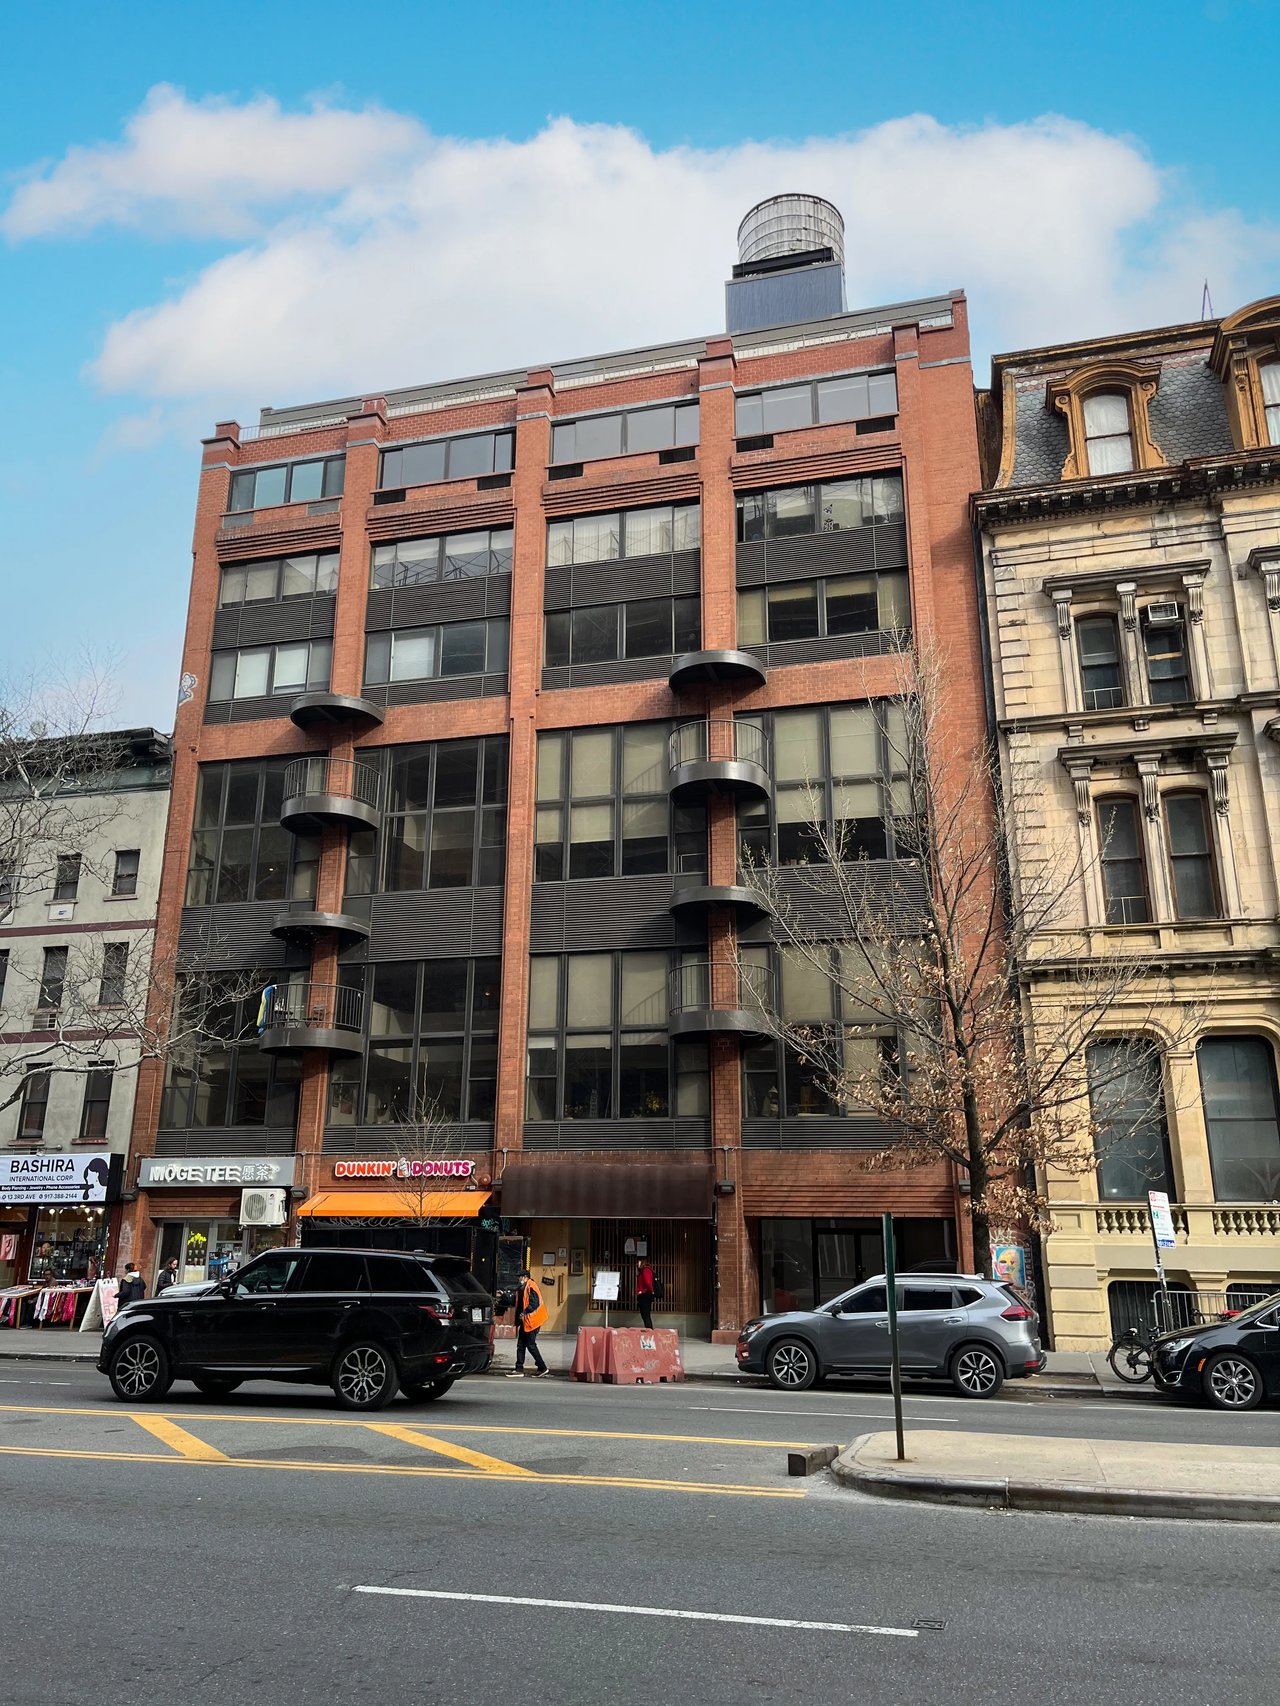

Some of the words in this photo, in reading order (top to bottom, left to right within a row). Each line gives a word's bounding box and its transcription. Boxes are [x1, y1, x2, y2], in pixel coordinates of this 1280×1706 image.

[10, 1159, 75, 1173] BASHIRA
[204, 1165, 242, 1182] TEE
[335, 1161, 397, 1177] DUNKIN'
[412, 1160, 472, 1177] DONUTS
[9, 1174, 55, 1182] INTERNATIONAL
